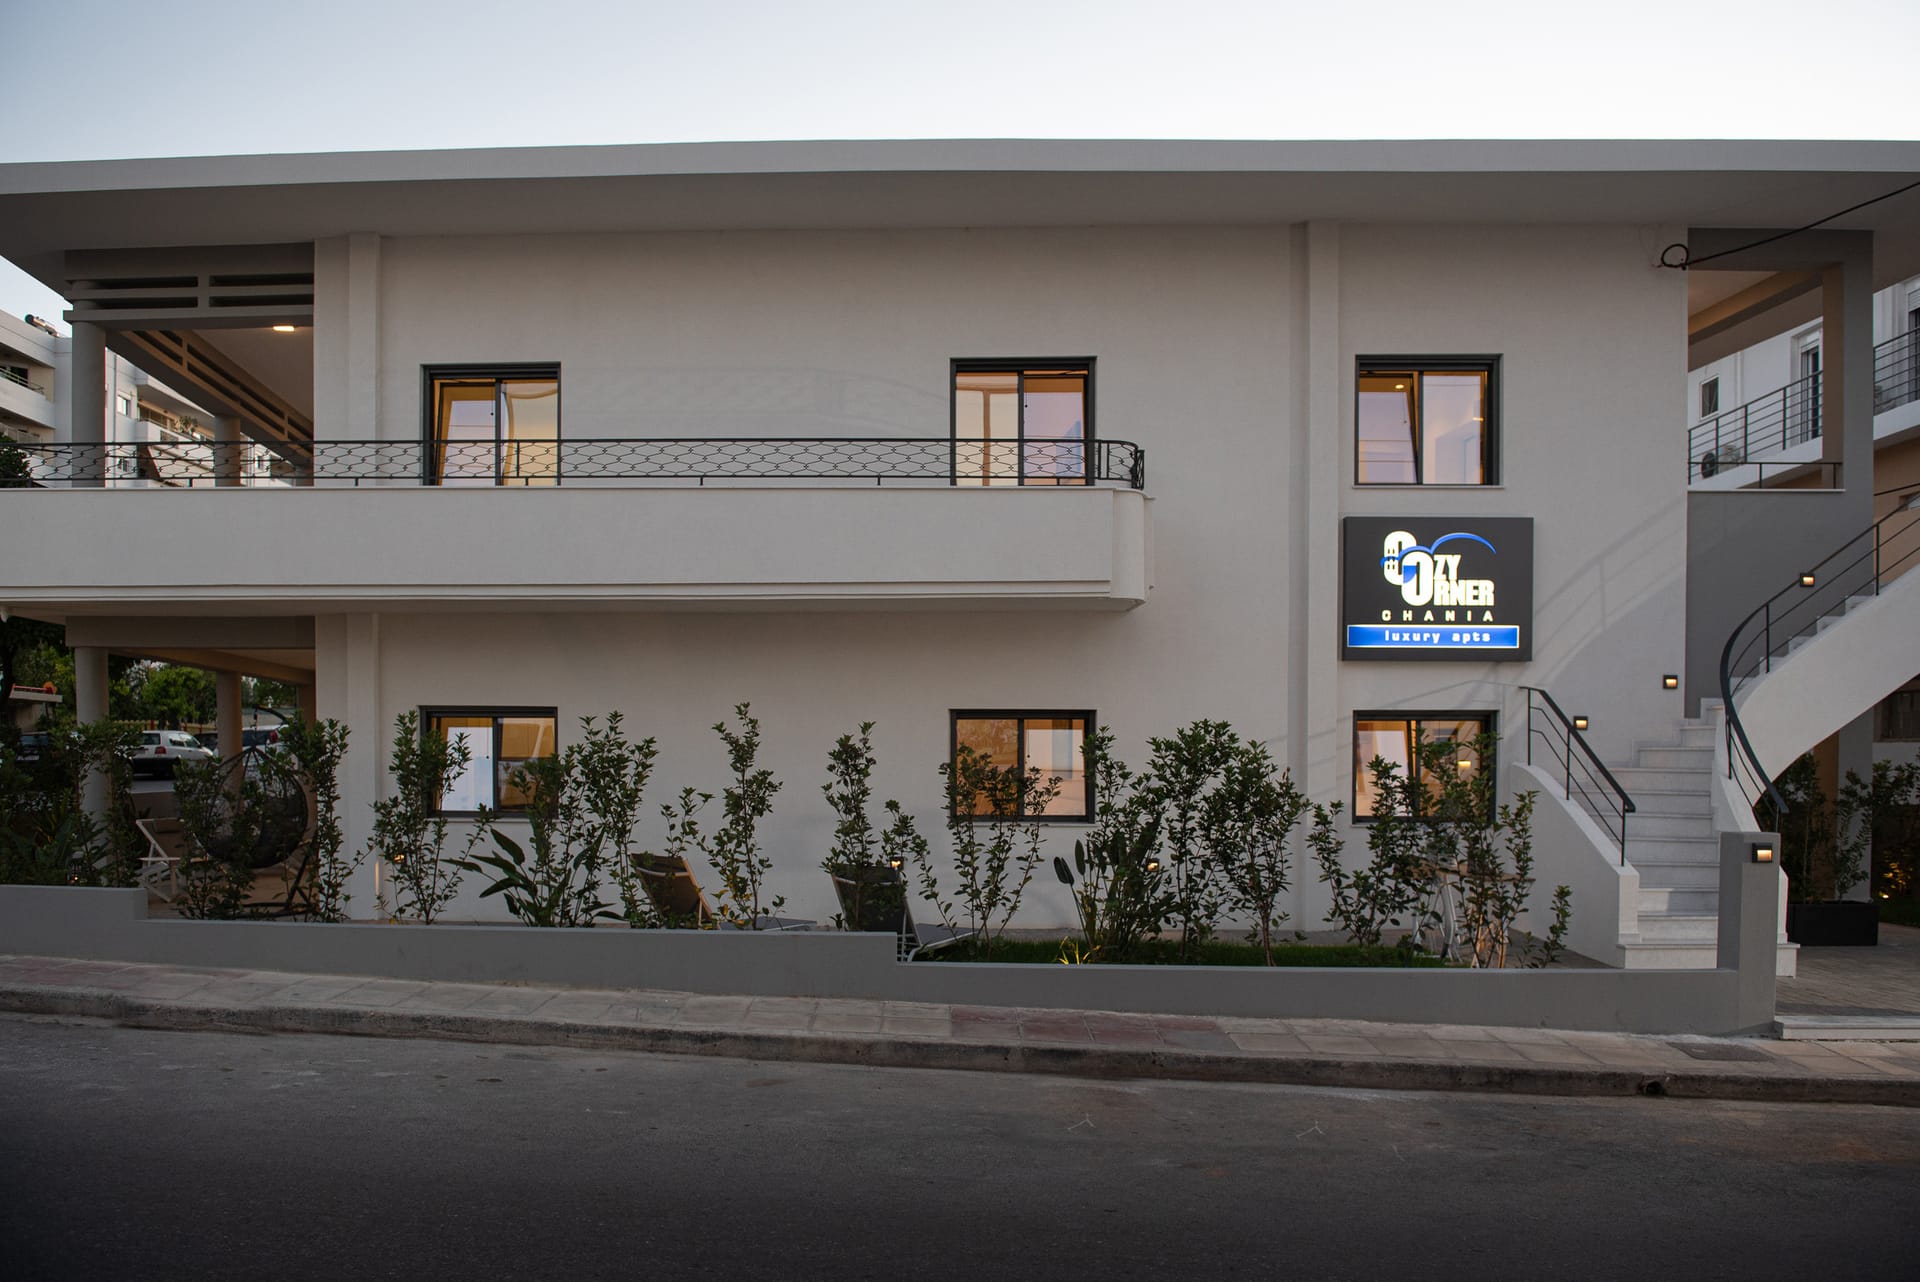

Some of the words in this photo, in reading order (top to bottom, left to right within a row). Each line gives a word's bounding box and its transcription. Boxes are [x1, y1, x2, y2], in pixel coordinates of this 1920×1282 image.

[1381, 610, 1494, 622] CHANIA
[1384, 630, 1441, 644] luxury
[1452, 631, 1491, 644] apts
